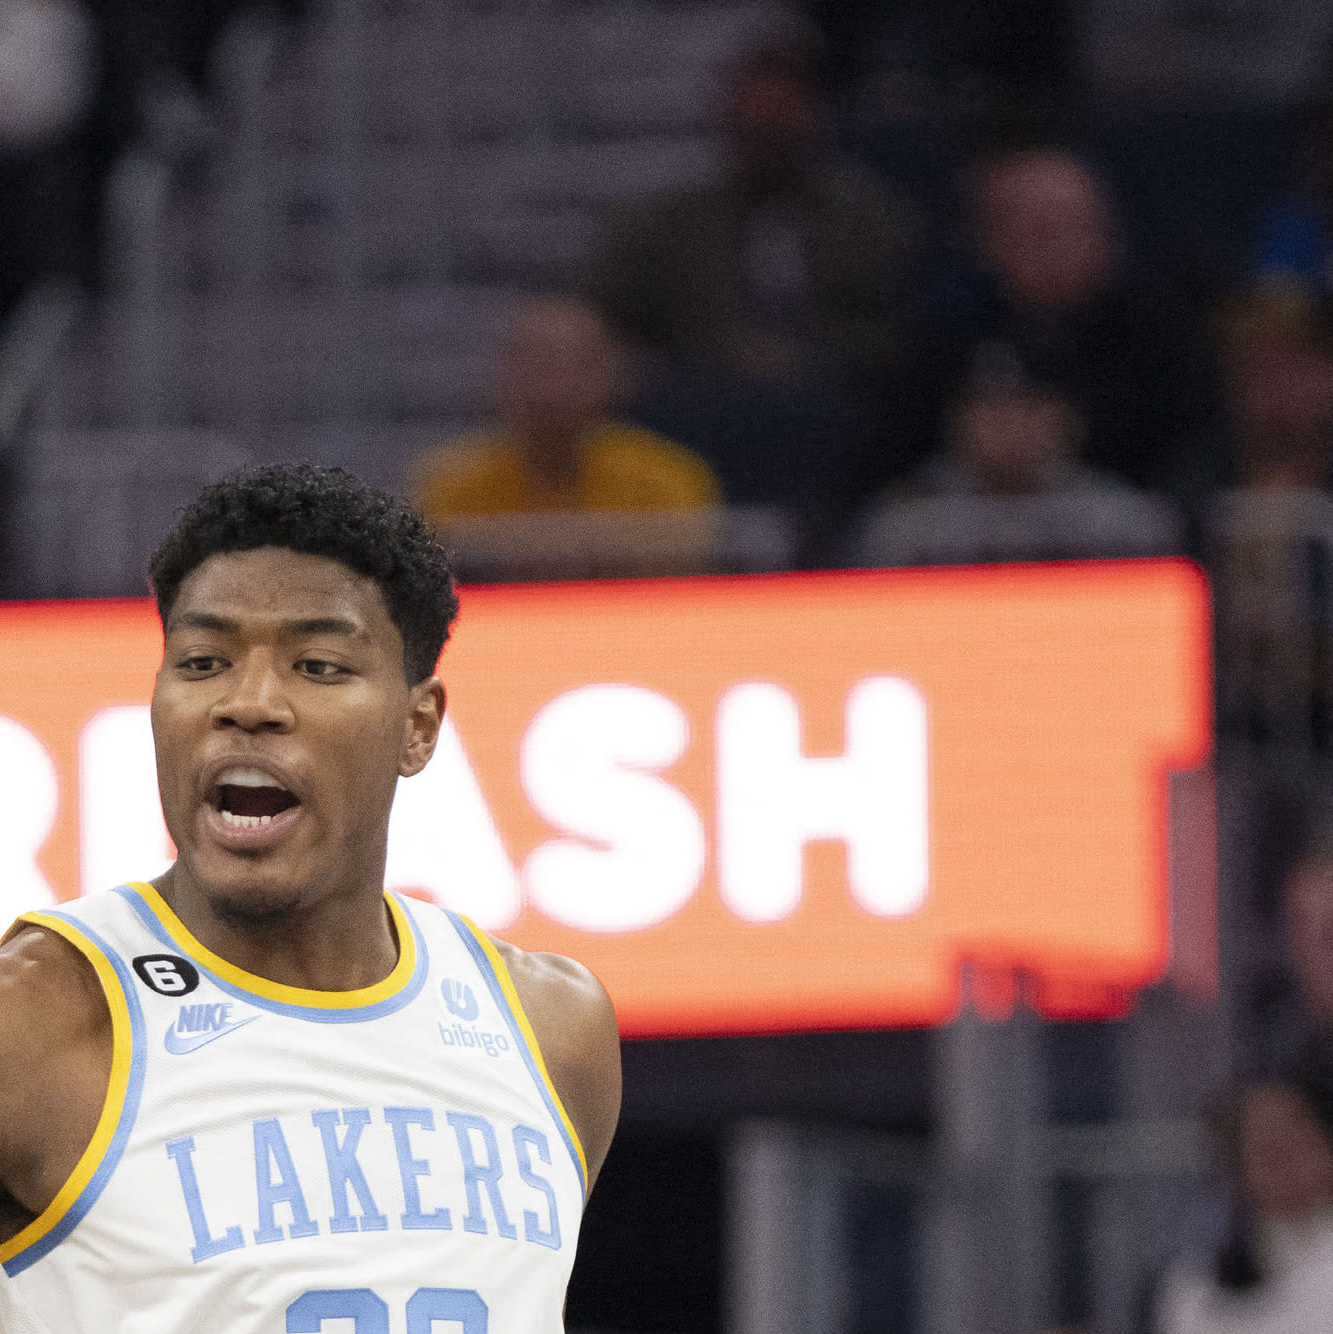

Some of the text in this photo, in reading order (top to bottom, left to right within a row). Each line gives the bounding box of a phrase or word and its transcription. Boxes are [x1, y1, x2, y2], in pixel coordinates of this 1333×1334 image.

[143, 960, 187, 992] 6
[176, 1003, 234, 1032] NIKE
[437, 1021, 510, 1058] bibigo
[165, 1106, 562, 1264] LAKERS
